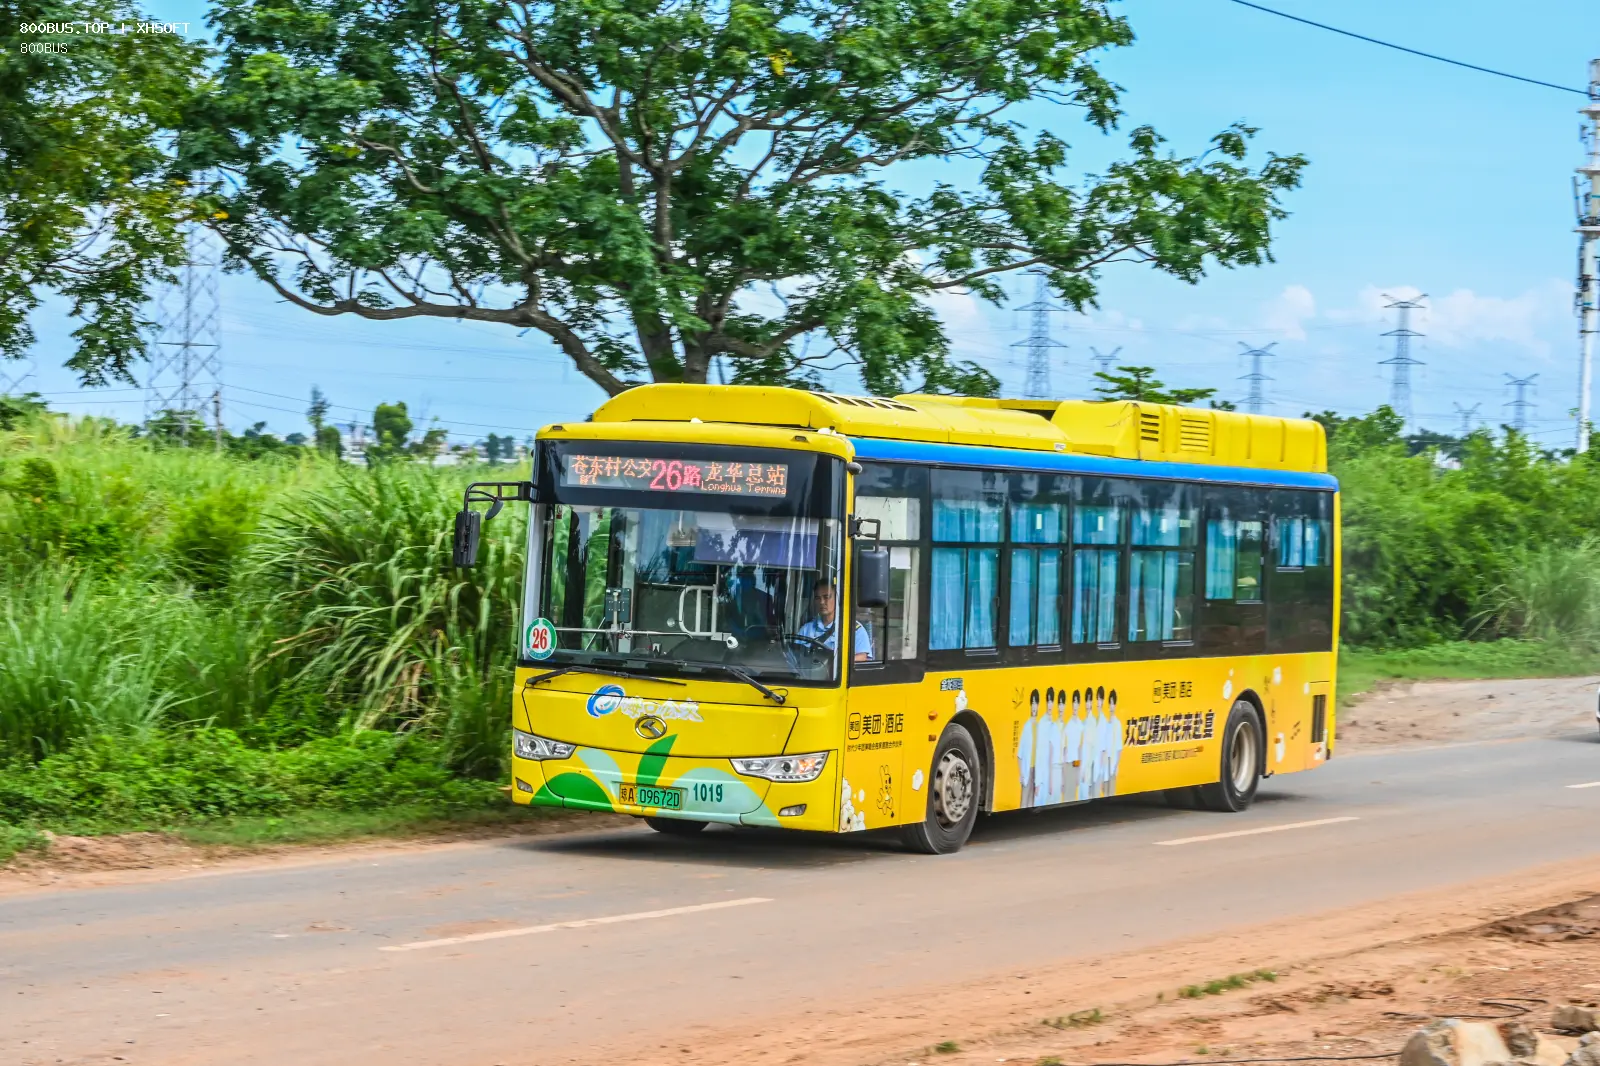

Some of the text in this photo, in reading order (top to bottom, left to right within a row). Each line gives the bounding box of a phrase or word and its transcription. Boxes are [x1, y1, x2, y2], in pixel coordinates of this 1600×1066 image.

[705, 462, 785, 485] 龙华总站
[701, 480, 787, 495] Longhua Termina
[532, 627, 548, 650] 26
[639, 788, 680, 807] 09672D
[693, 782, 723, 803] 1019
